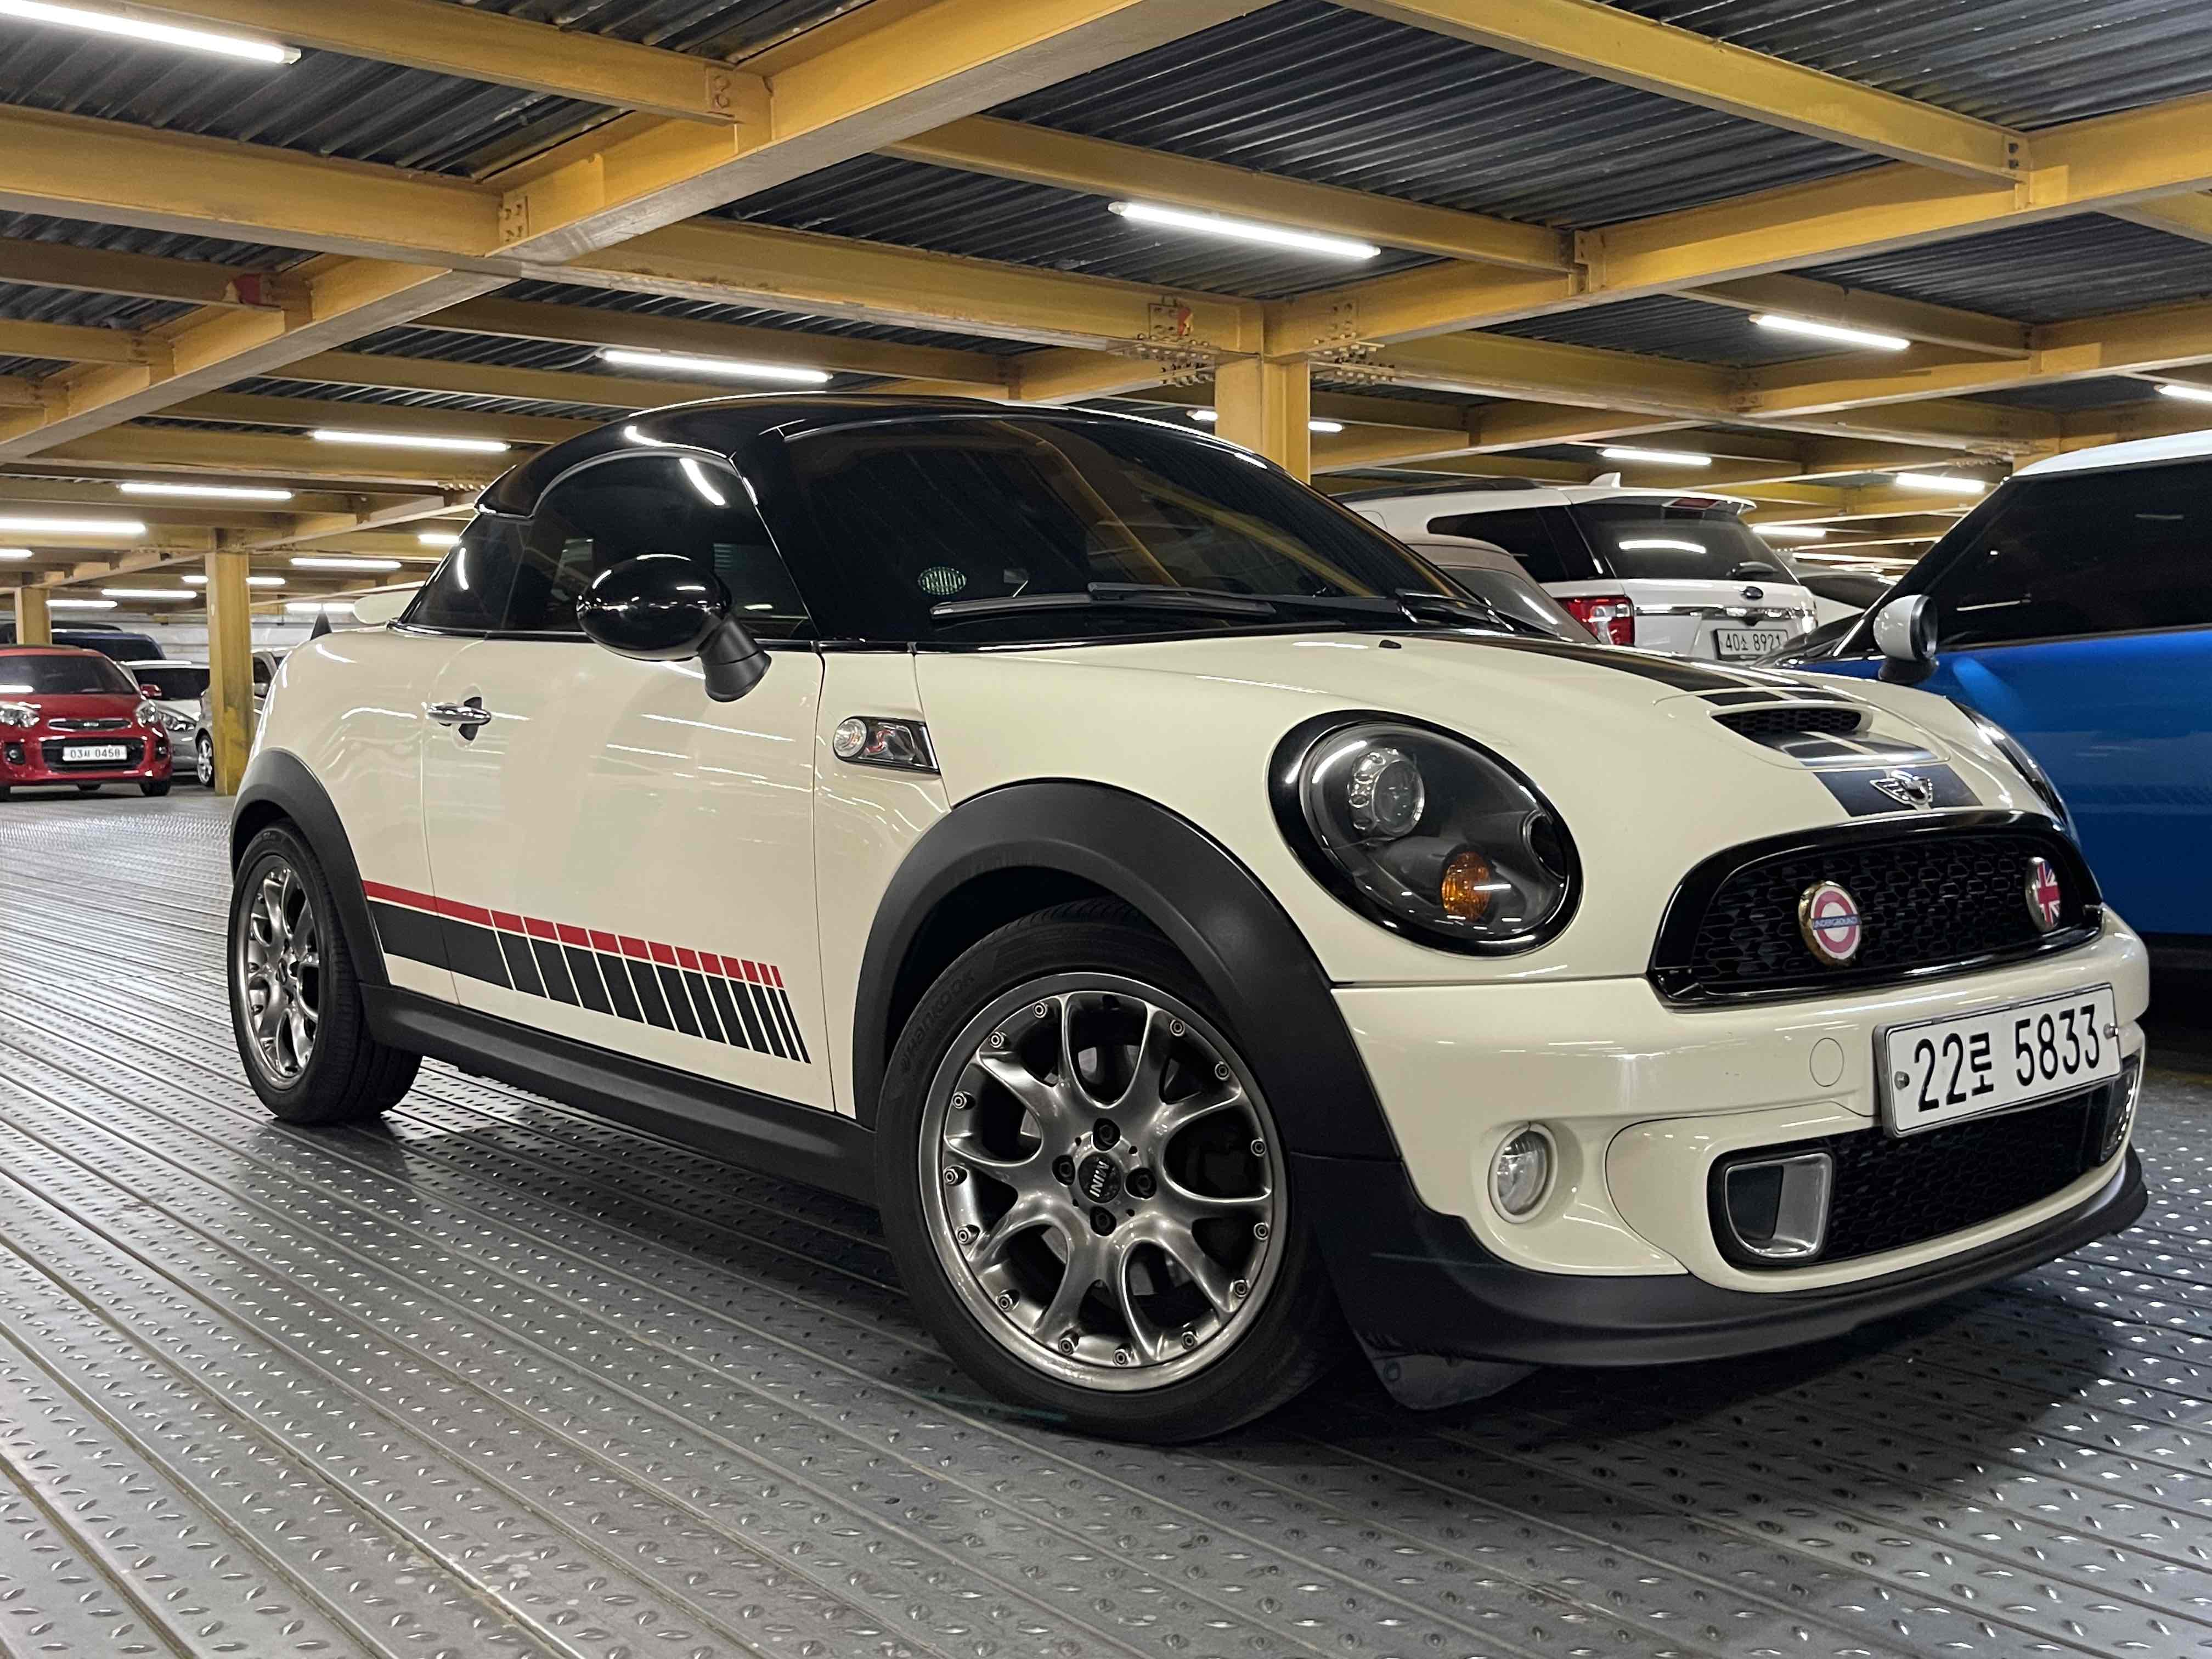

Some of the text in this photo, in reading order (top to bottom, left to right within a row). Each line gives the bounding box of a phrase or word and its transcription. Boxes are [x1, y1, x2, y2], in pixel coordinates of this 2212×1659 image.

[1725, 634, 1781, 651] 40소 8921
[1914, 1003, 2100, 1112] 22로 5833
[1089, 1160, 1109, 1197] MINI
